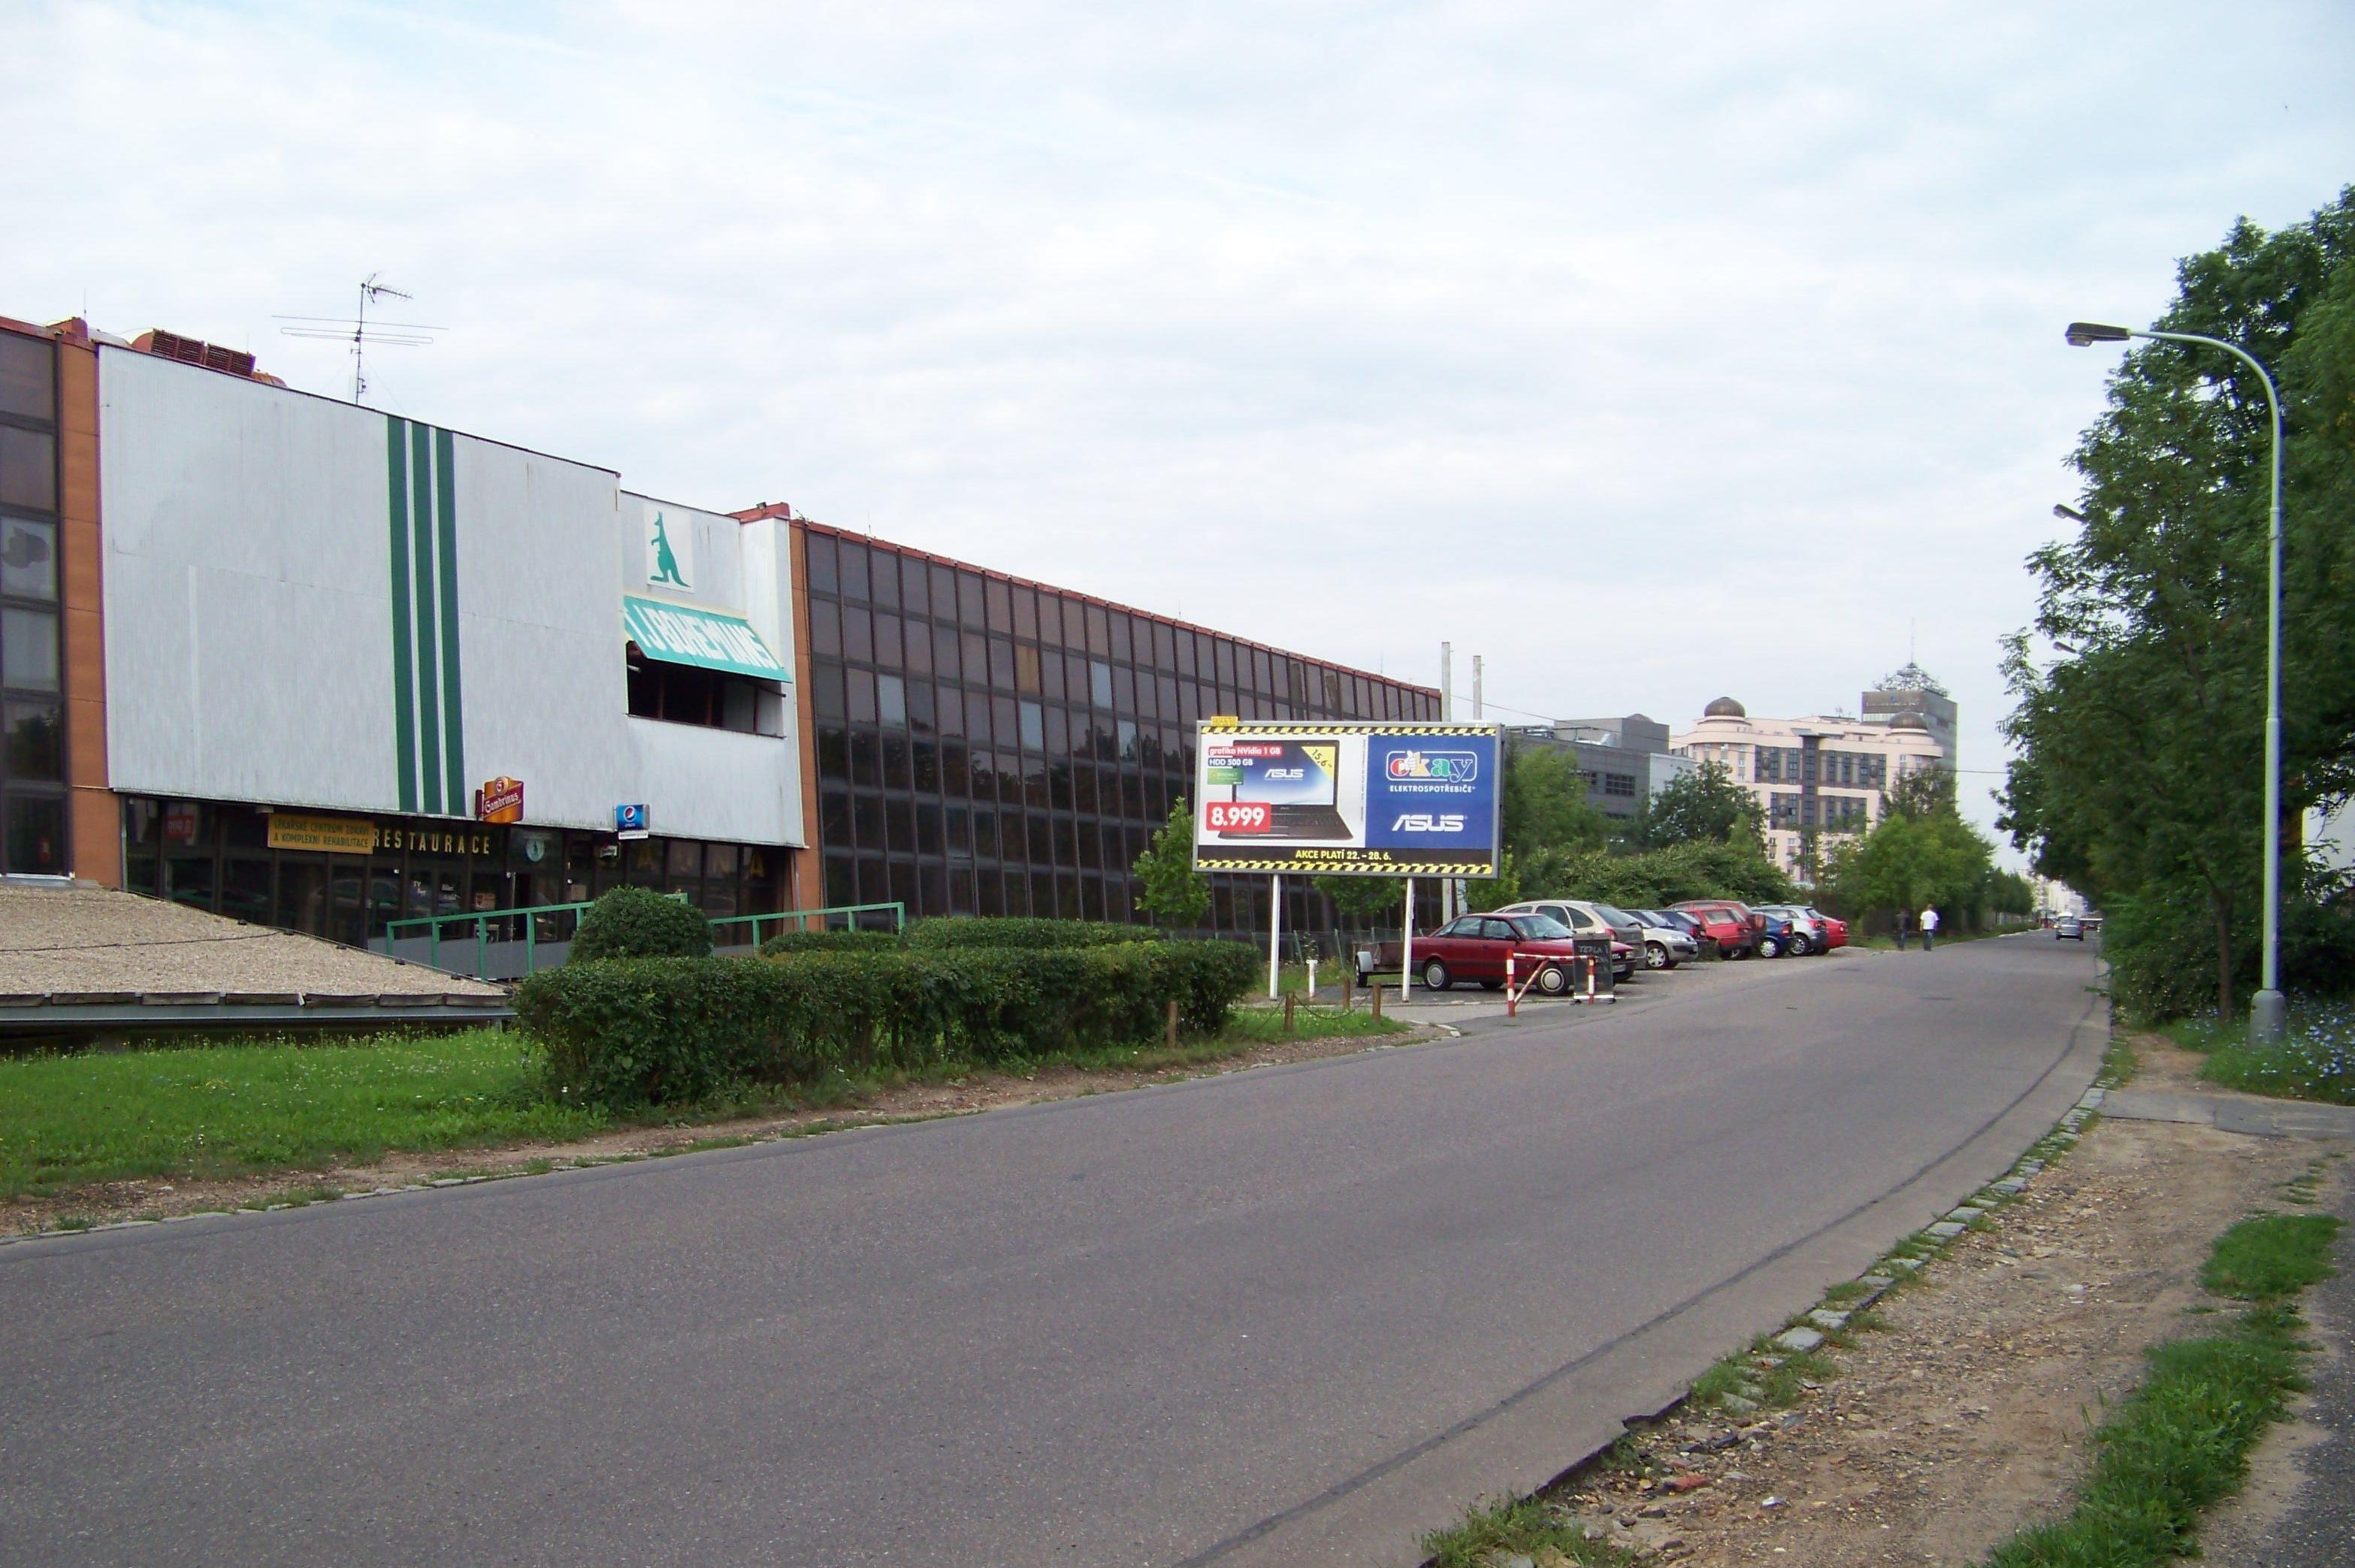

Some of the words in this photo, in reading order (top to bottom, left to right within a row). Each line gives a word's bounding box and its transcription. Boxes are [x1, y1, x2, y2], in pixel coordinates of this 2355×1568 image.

[1209, 746, 1236, 756] grafika
[1269, 747, 1281, 755] GB
[1209, 758, 1226, 766] HDD
[1227, 758, 1241, 766] 500
[1264, 769, 1304, 778] ASUS
[1211, 806, 1265, 826] 8.999
[1392, 814, 1465, 832] ASUS
[373, 828, 491, 854] RESTAURACE
[1295, 850, 1319, 859] AKCE
[1320, 849, 1345, 860] PLATÍ
